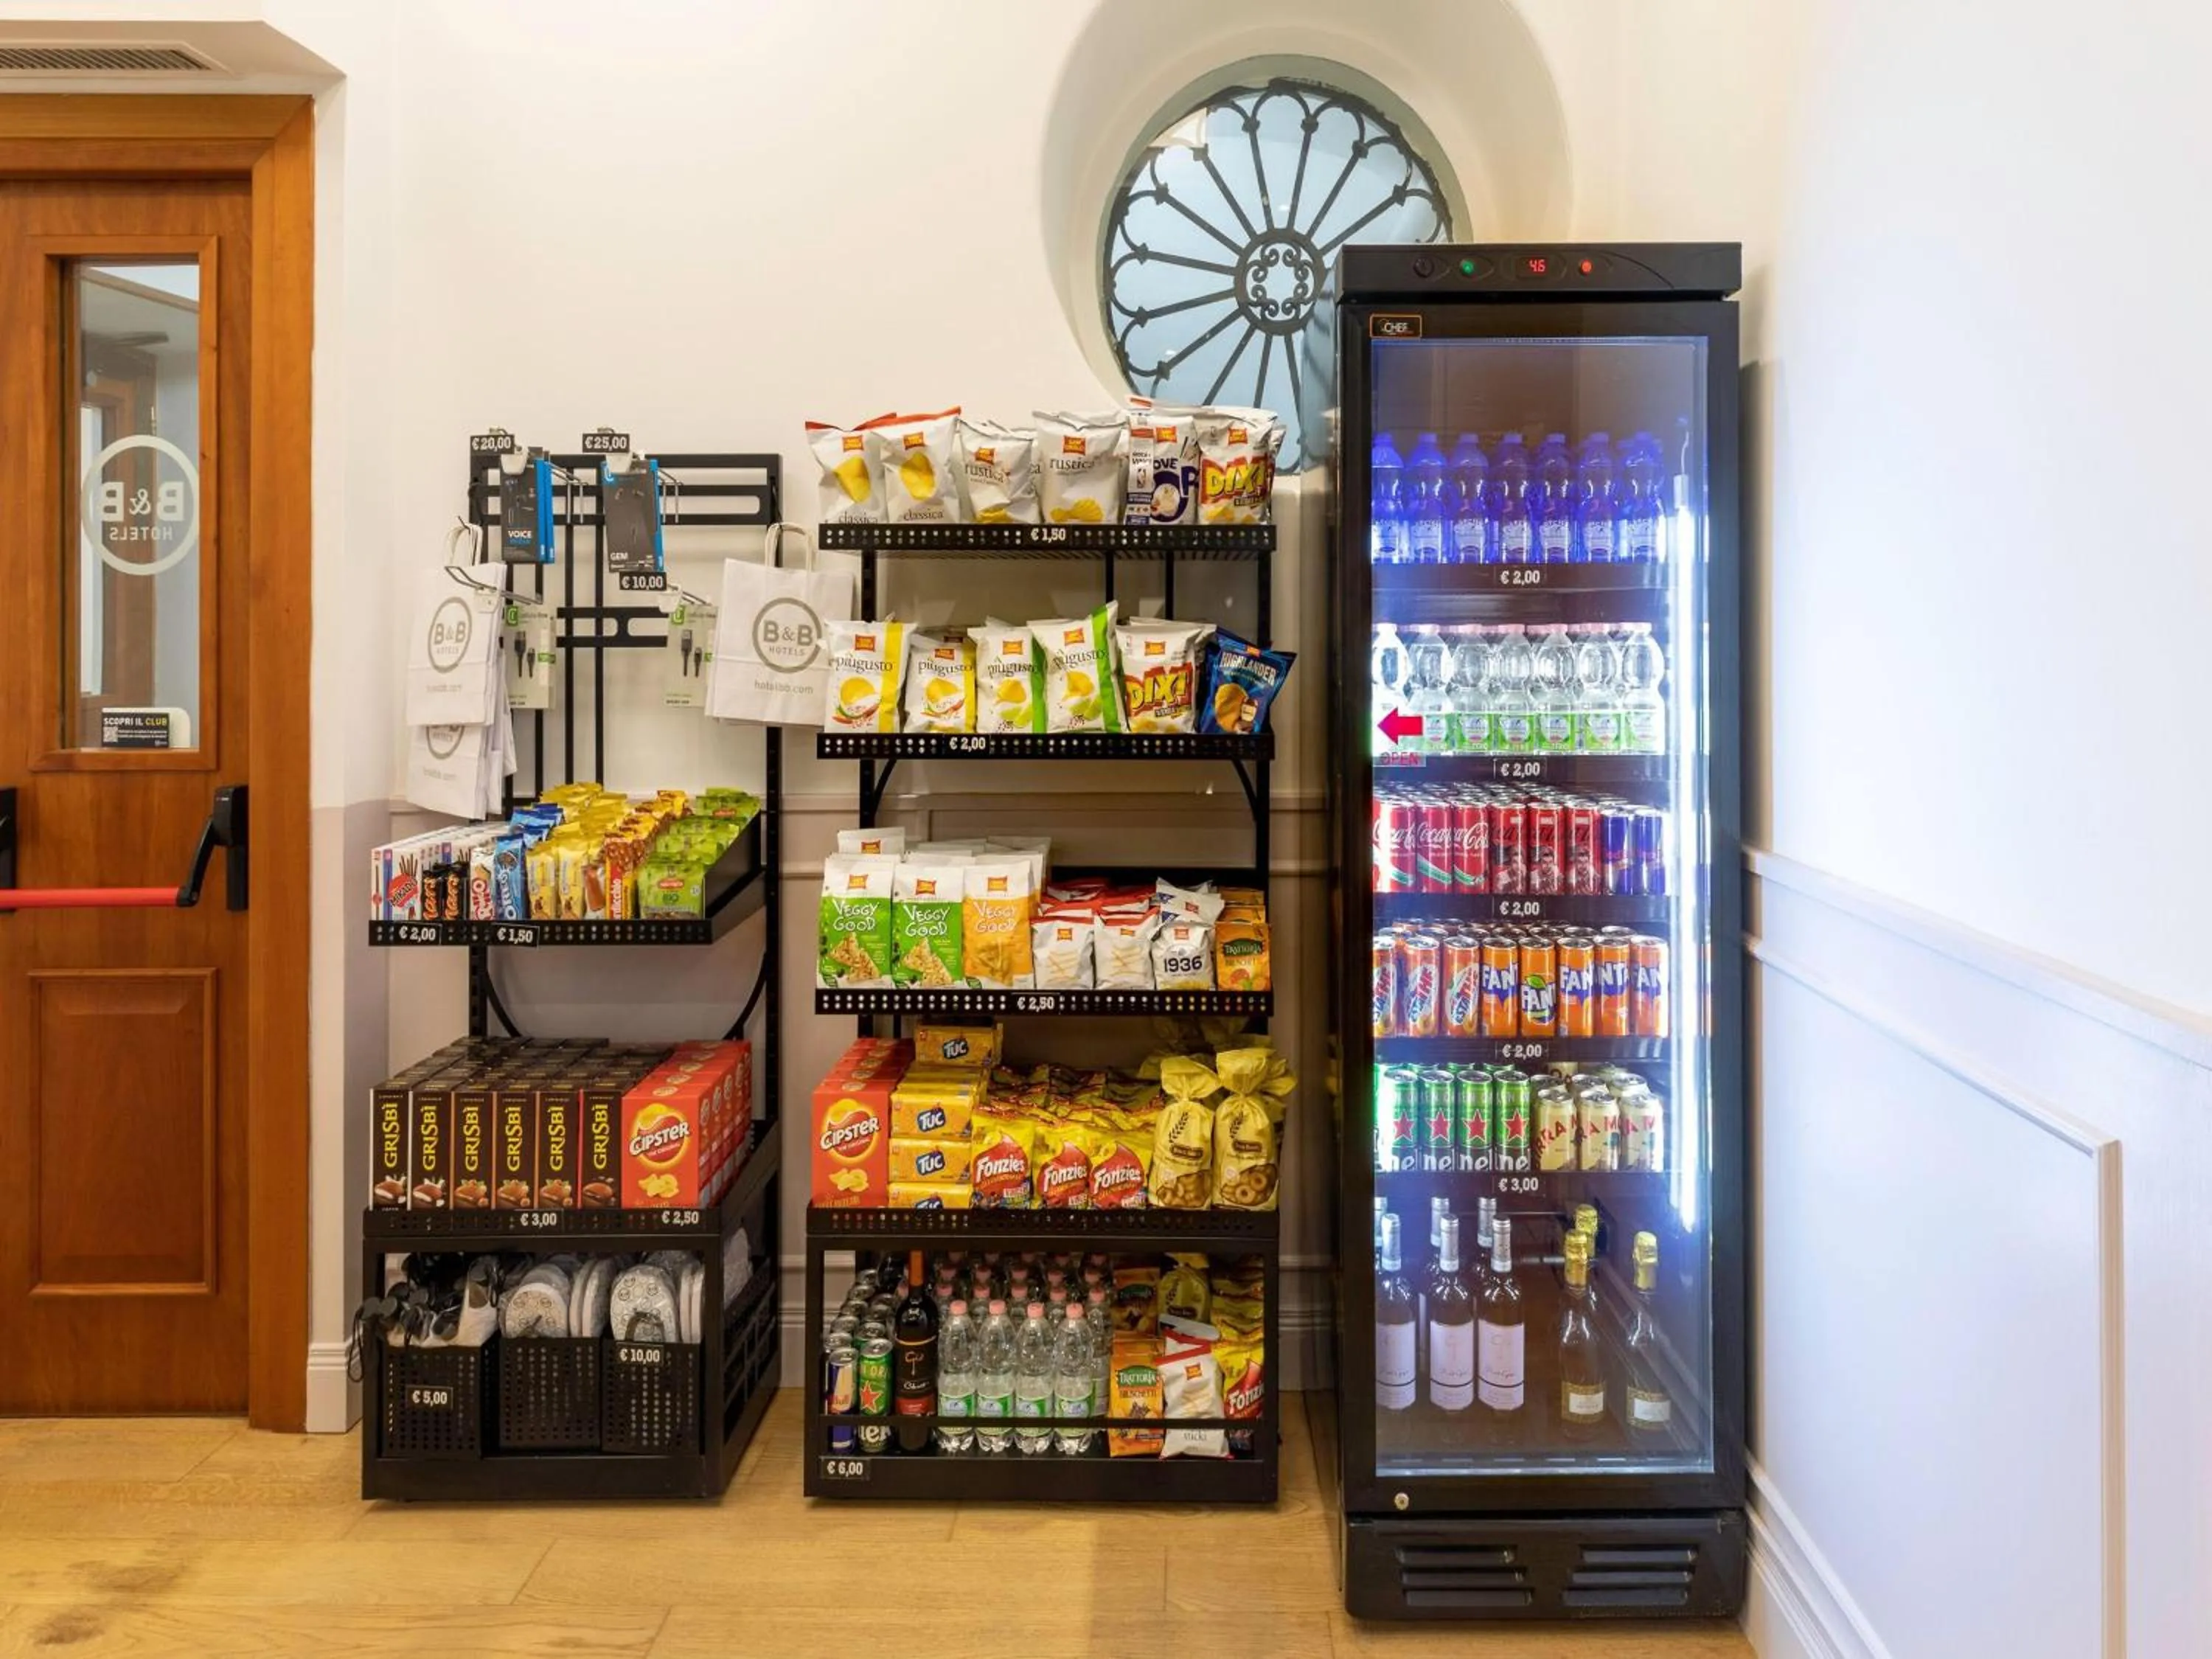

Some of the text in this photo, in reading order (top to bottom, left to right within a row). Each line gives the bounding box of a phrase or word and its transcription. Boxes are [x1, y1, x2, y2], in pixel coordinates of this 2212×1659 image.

[1050, 456, 1094, 470] rustica
[904, 508, 944, 521] classica
[508, 531, 532, 539] VOICE
[1031, 528, 1067, 543] € 1,50
[1500, 570, 1540, 585] € 2,00
[434, 621, 466, 644] B&B
[763, 620, 813, 646] B&B
[769, 646, 805, 657] HOTELS
[1220, 651, 1277, 684] HIGHLANDER
[104, 717, 167, 726] SCOPRI IL CLUB
[949, 737, 986, 752] € 2,00
[1380, 751, 1420, 765] OPEN
[1500, 762, 1540, 777] € 2,00
[832, 898, 879, 917] VEGGY
[903, 905, 950, 922] VEGGY
[973, 901, 1017, 918] VEGGY
[1500, 901, 1540, 917] € 2,00
[832, 917, 876, 931] GOOD
[905, 922, 947, 937] GOOD
[974, 917, 1018, 932] GOOD
[399, 926, 436, 942] € 2,00
[497, 928, 533, 944] € 1,50
[1164, 956, 1202, 973] 1936
[1017, 996, 1055, 1012] € 2,50
[1502, 1043, 1542, 1059] € 2,00
[977, 1153, 1025, 1182] Fonzies
[1043, 1162, 1088, 1192] Fonzies
[1094, 1165, 1141, 1194] Fonzies
[1498, 1178, 1539, 1194] € 3,00
[521, 1213, 557, 1227] € 3,00
[662, 1211, 699, 1225] € 2,50
[620, 1349, 661, 1363] € 10,00
[412, 1391, 448, 1407] € 5,00
[827, 1461, 863, 1477] € 6,00
